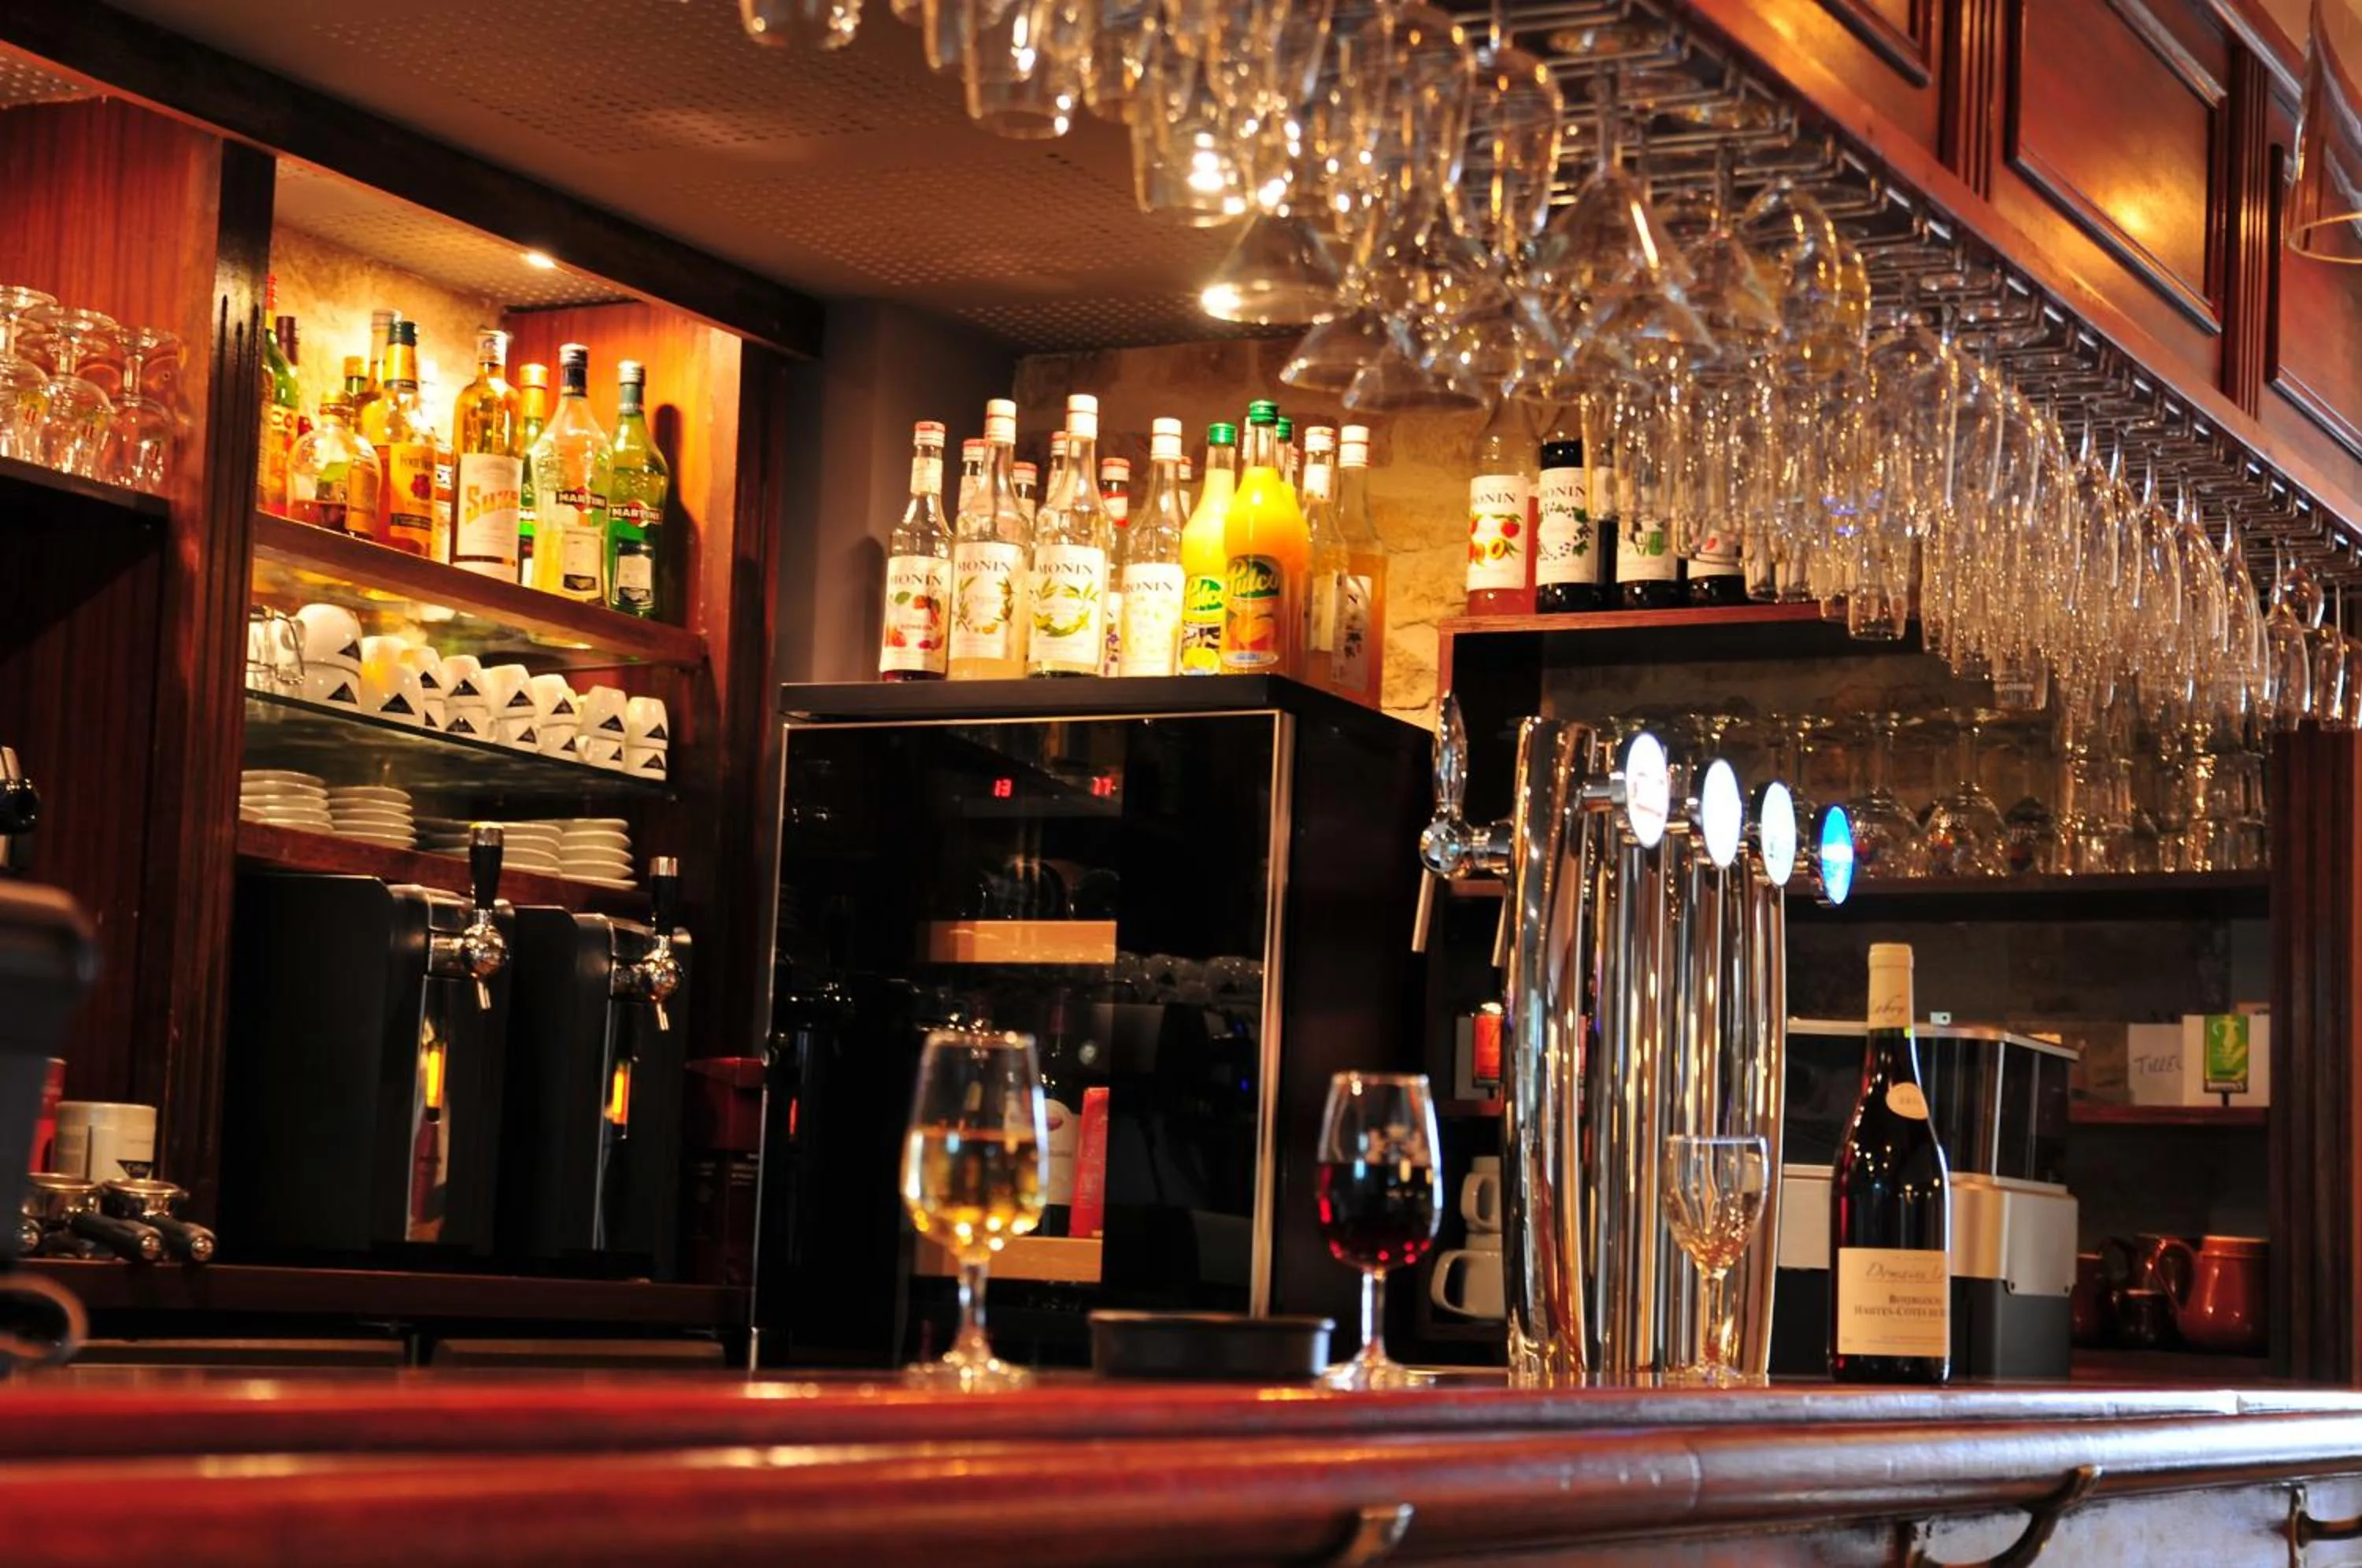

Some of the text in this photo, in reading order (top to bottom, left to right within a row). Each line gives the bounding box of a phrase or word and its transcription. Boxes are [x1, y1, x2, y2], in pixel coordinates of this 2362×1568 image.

[557, 491, 605, 508] MARTINI
[611, 507, 661, 523] MARTINI
[958, 560, 1011, 572] MONIN
[1038, 562, 1094, 575] MONIN
[994, 778, 1013, 797] 13
